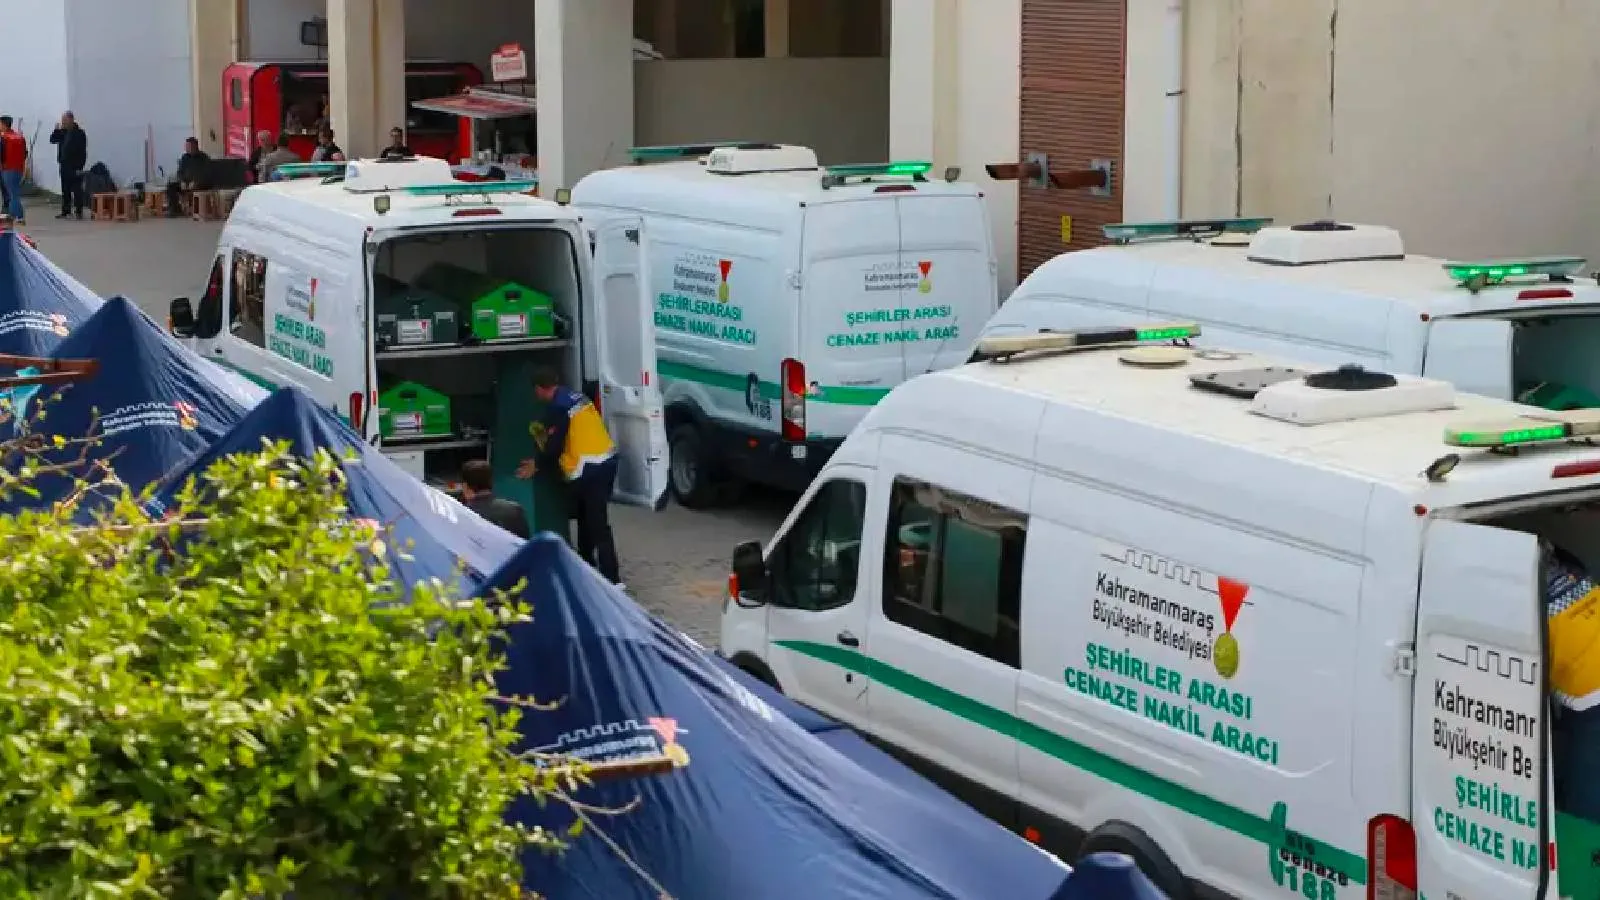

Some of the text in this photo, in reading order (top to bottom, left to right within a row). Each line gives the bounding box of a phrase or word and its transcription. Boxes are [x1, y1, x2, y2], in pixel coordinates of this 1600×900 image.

[653, 312, 687, 331] ENAZE
[826, 331, 880, 348] CENAZE
[1092, 599, 1212, 660] Büyükşehir Belediyesi
[1096, 571, 1215, 637] Kahramanmaraş
[1086, 642, 1252, 721] ŞEHİRLER ARASI
[1064, 666, 1279, 766] CENAZE NAKİL ARACI
[1433, 716, 1508, 771] Büyükşehir
[1455, 774, 1538, 829] ŞEHİRLE
[1434, 806, 1539, 870] CENAZE NA
[1285, 866, 1336, 900] 188
